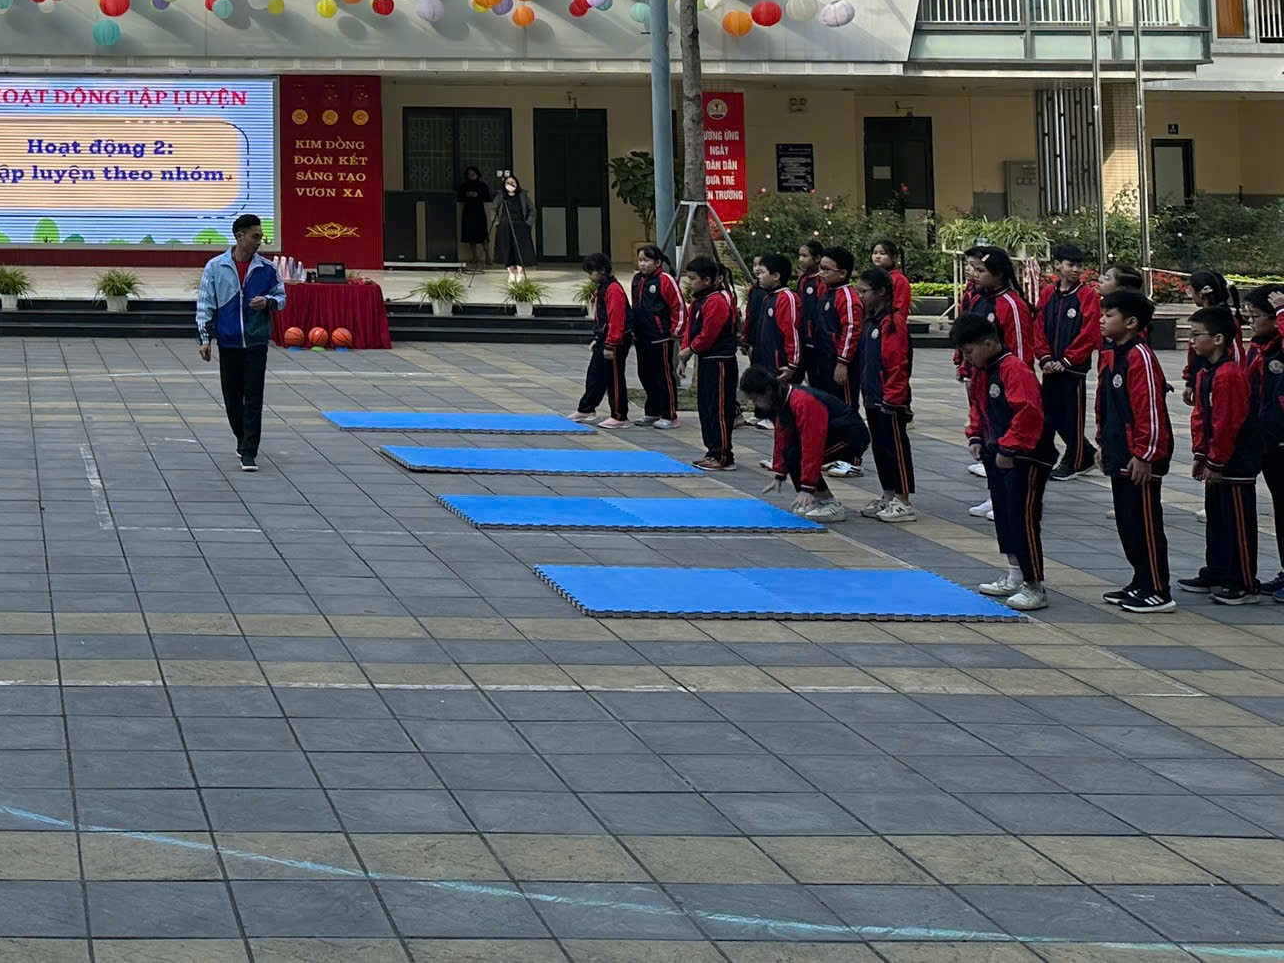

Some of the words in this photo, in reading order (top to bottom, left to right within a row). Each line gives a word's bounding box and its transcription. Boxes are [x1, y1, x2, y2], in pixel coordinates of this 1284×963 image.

[53, 86, 121, 108] ĐỘNG
[124, 86, 168, 109] TẬP
[173, 87, 248, 110] LUYỆN
[27, 138, 82, 158] Hoạt
[89, 138, 146, 159] động
[153, 140, 173, 155] 2:
[295, 140, 322, 150] KIM
[325, 136, 365, 150] ĐỒNG
[709, 143, 729, 156] NGÀY
[293, 154, 333, 165] ĐOÀN
[338, 152, 368, 166] KẾT
[722, 157, 738, 170] DÂN
[31, 164, 96, 184] luyện
[102, 165, 153, 181] theo
[296, 169, 333, 182] SÁNG
[337, 172, 366, 183] TẠO
[295, 187, 336, 197] VƯƠN
[342, 188, 364, 198] XA
[715, 187, 744, 201] TRƯỜNG
